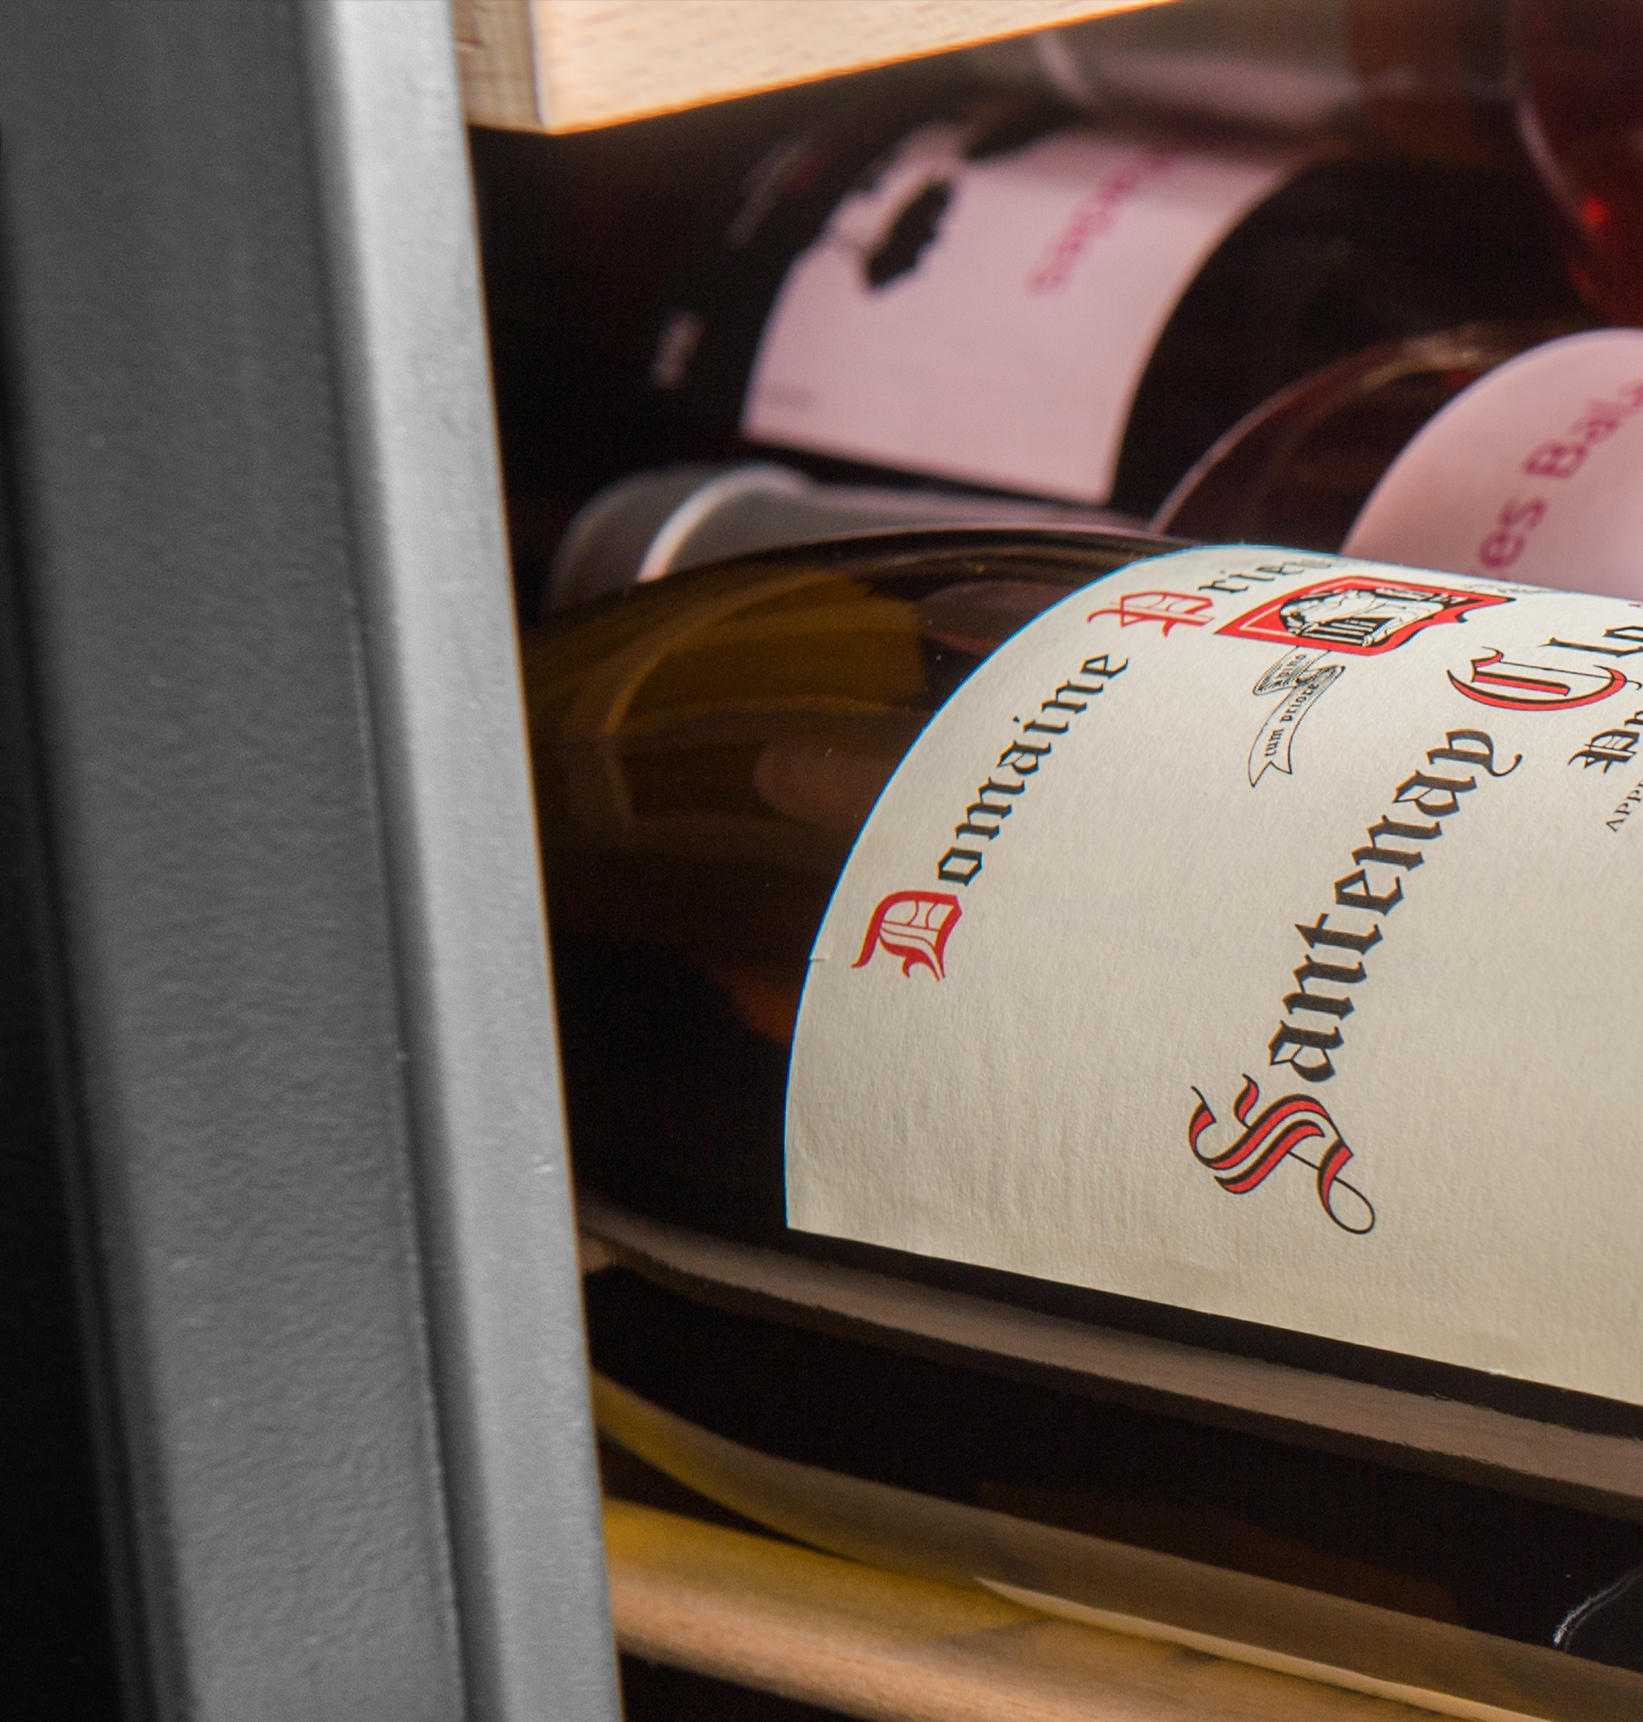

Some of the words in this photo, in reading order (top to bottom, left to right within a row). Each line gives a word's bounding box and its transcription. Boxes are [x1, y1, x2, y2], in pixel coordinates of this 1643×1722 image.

[1477, 499, 1548, 572] es
[851, 653, 1129, 982] Domaine
[1189, 727, 1522, 1234] Santenay
